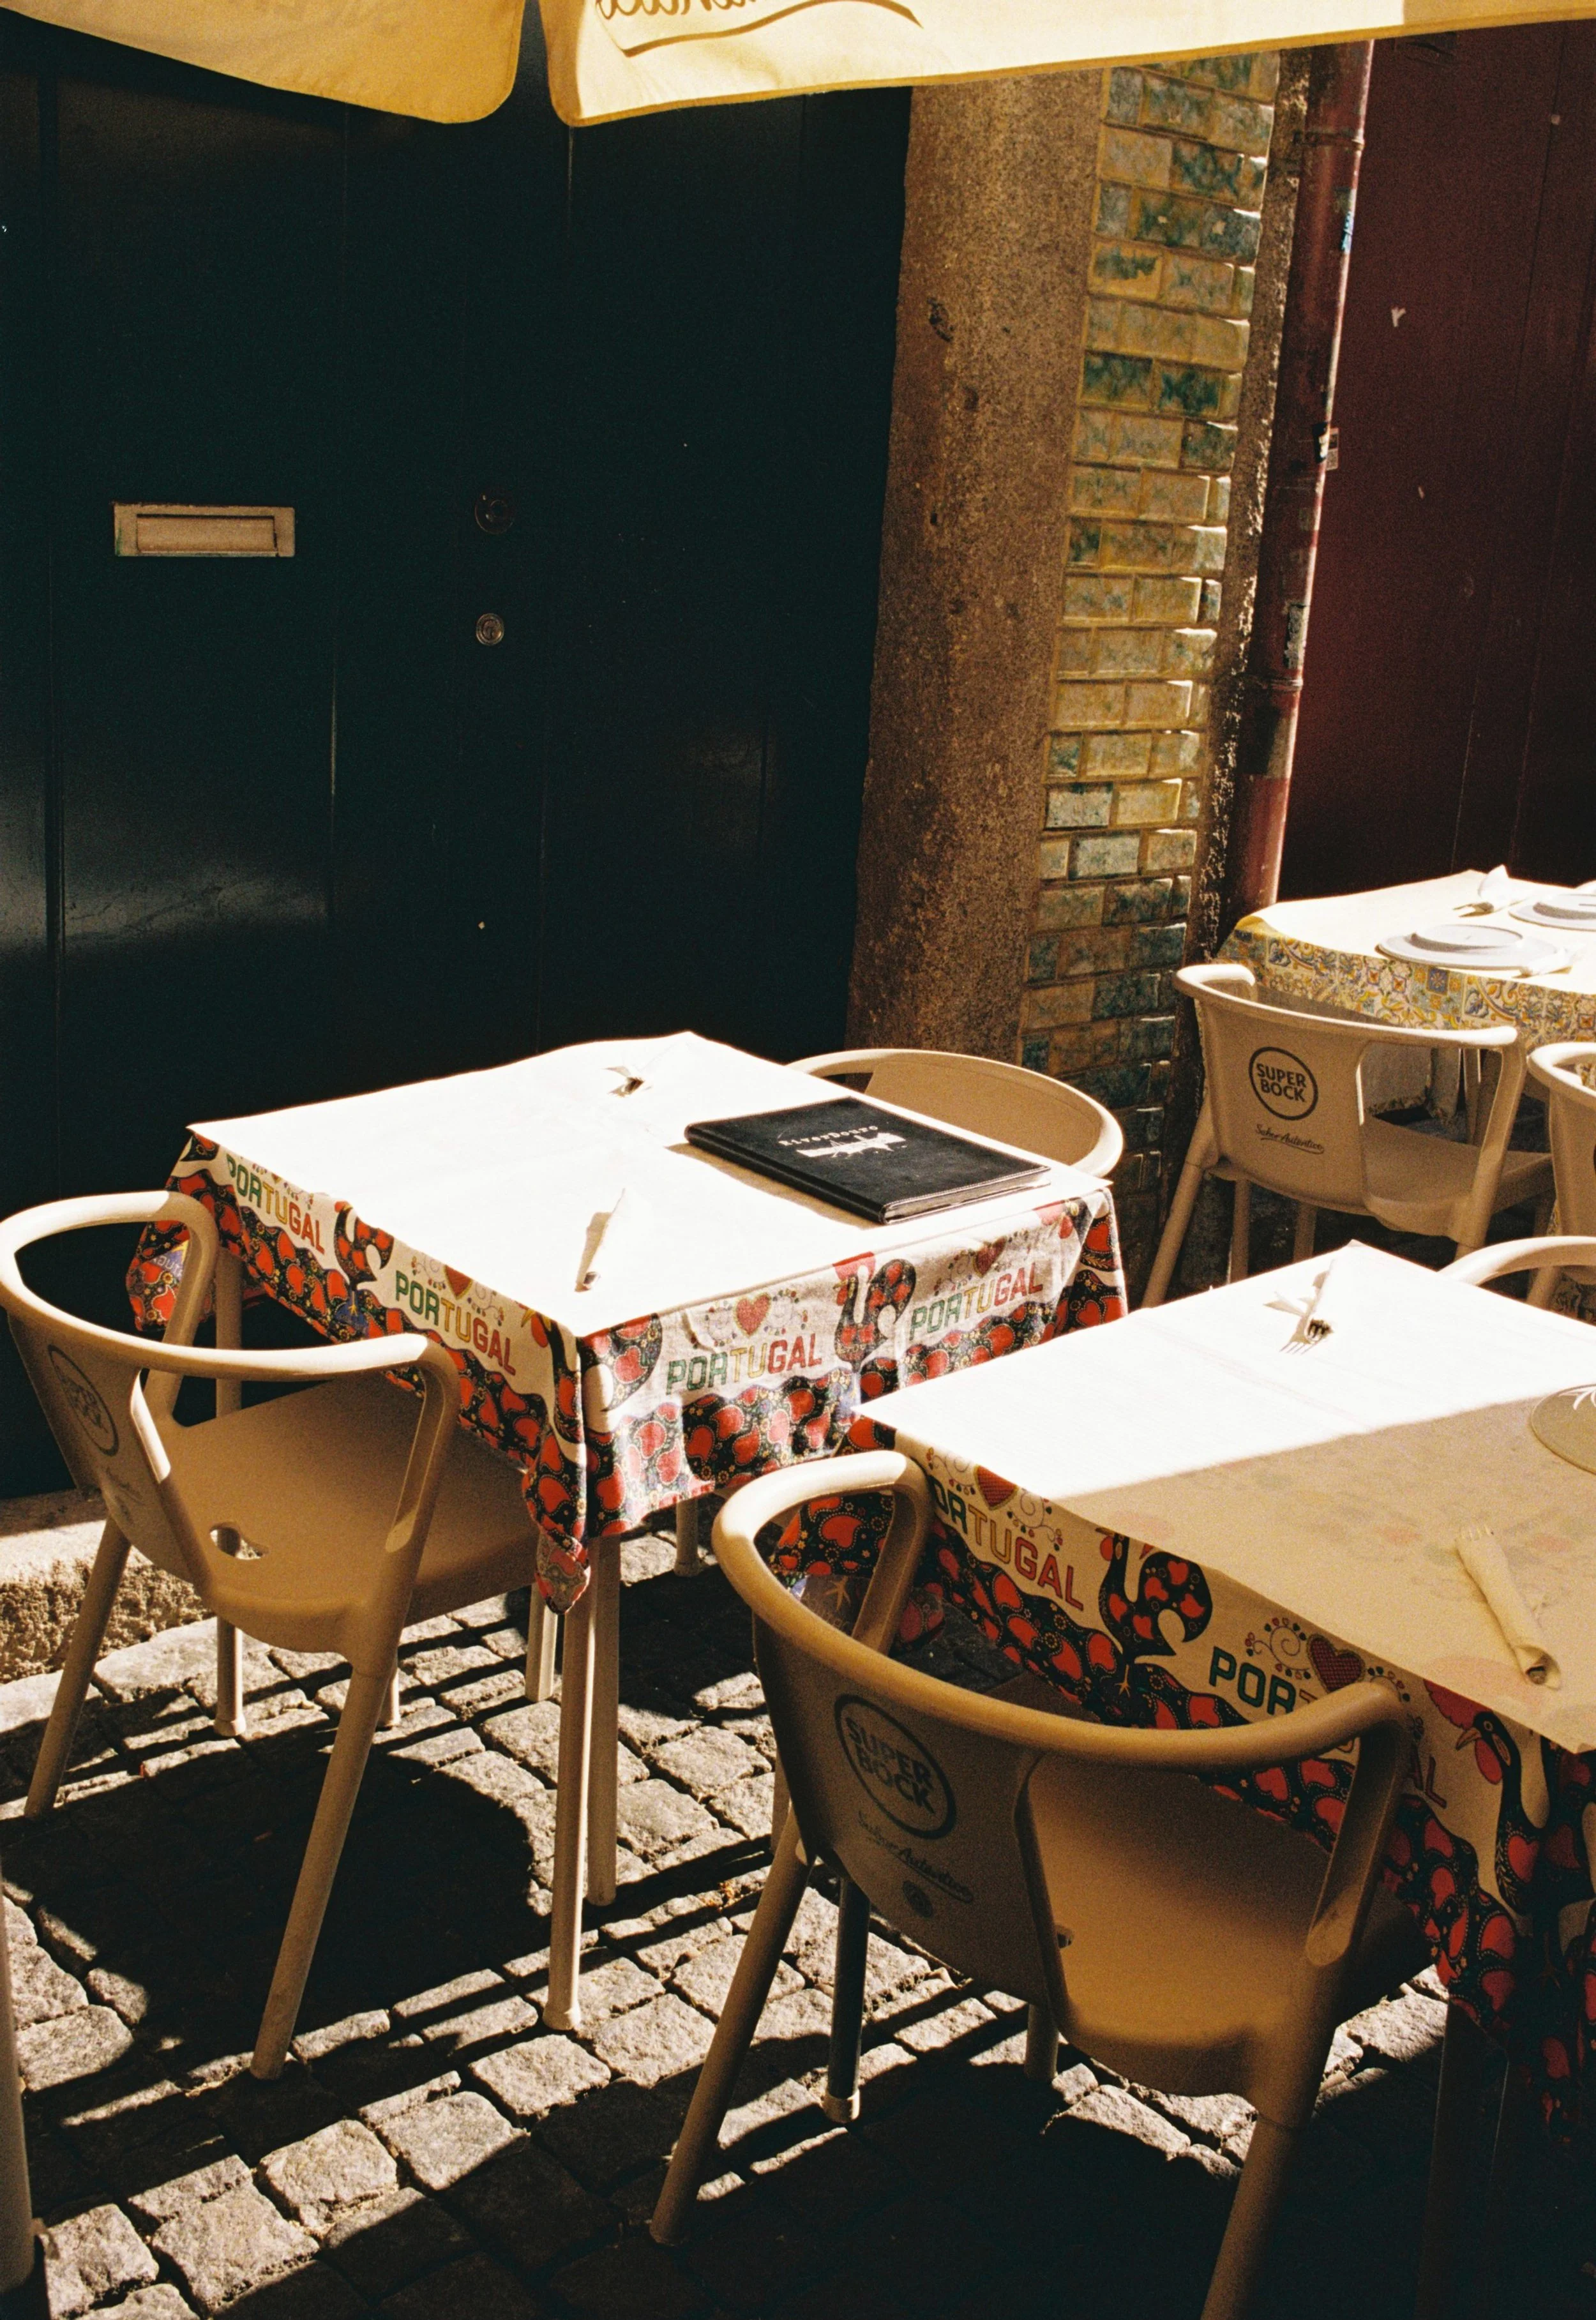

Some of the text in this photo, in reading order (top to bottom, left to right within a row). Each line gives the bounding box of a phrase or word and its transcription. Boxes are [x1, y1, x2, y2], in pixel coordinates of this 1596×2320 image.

[1256, 1063, 1307, 1088] SUPER
[1260, 1079, 1306, 1103] BOCK
[396, 1270, 516, 1376] PORTUGAL
[909, 1262, 1043, 1341] PORTUGAL
[666, 1333, 822, 1396] PORTUGAL
[928, 1475, 1084, 1611] ORTUGAL
[846, 1717, 934, 1792] SUPER
[855, 1743, 935, 1814] BOCK
